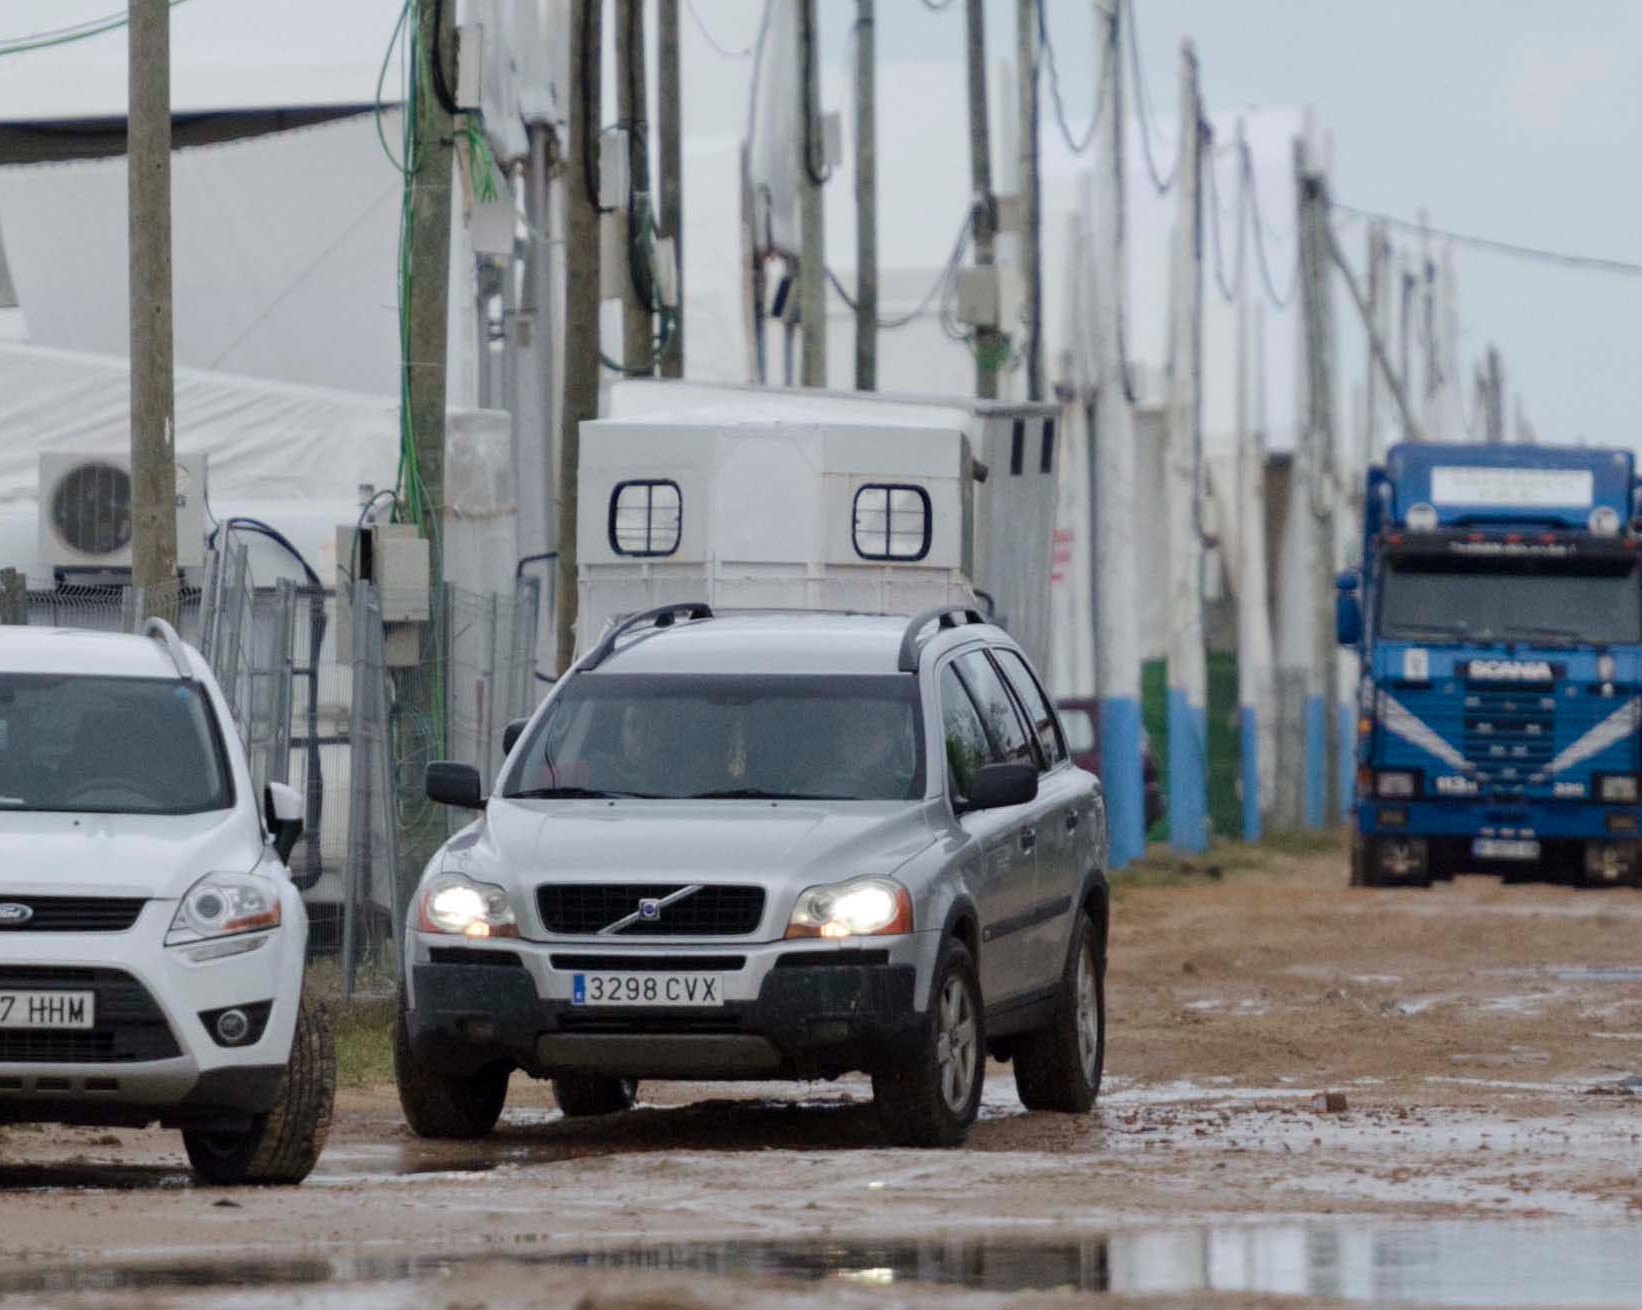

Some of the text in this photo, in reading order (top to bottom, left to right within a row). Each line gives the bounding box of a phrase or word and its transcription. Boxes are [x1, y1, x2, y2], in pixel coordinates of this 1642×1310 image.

[1468, 660, 1554, 681] SCANIA
[590, 976, 717, 1001] 3298 CVX
[28, 996, 85, 1023] HHM
